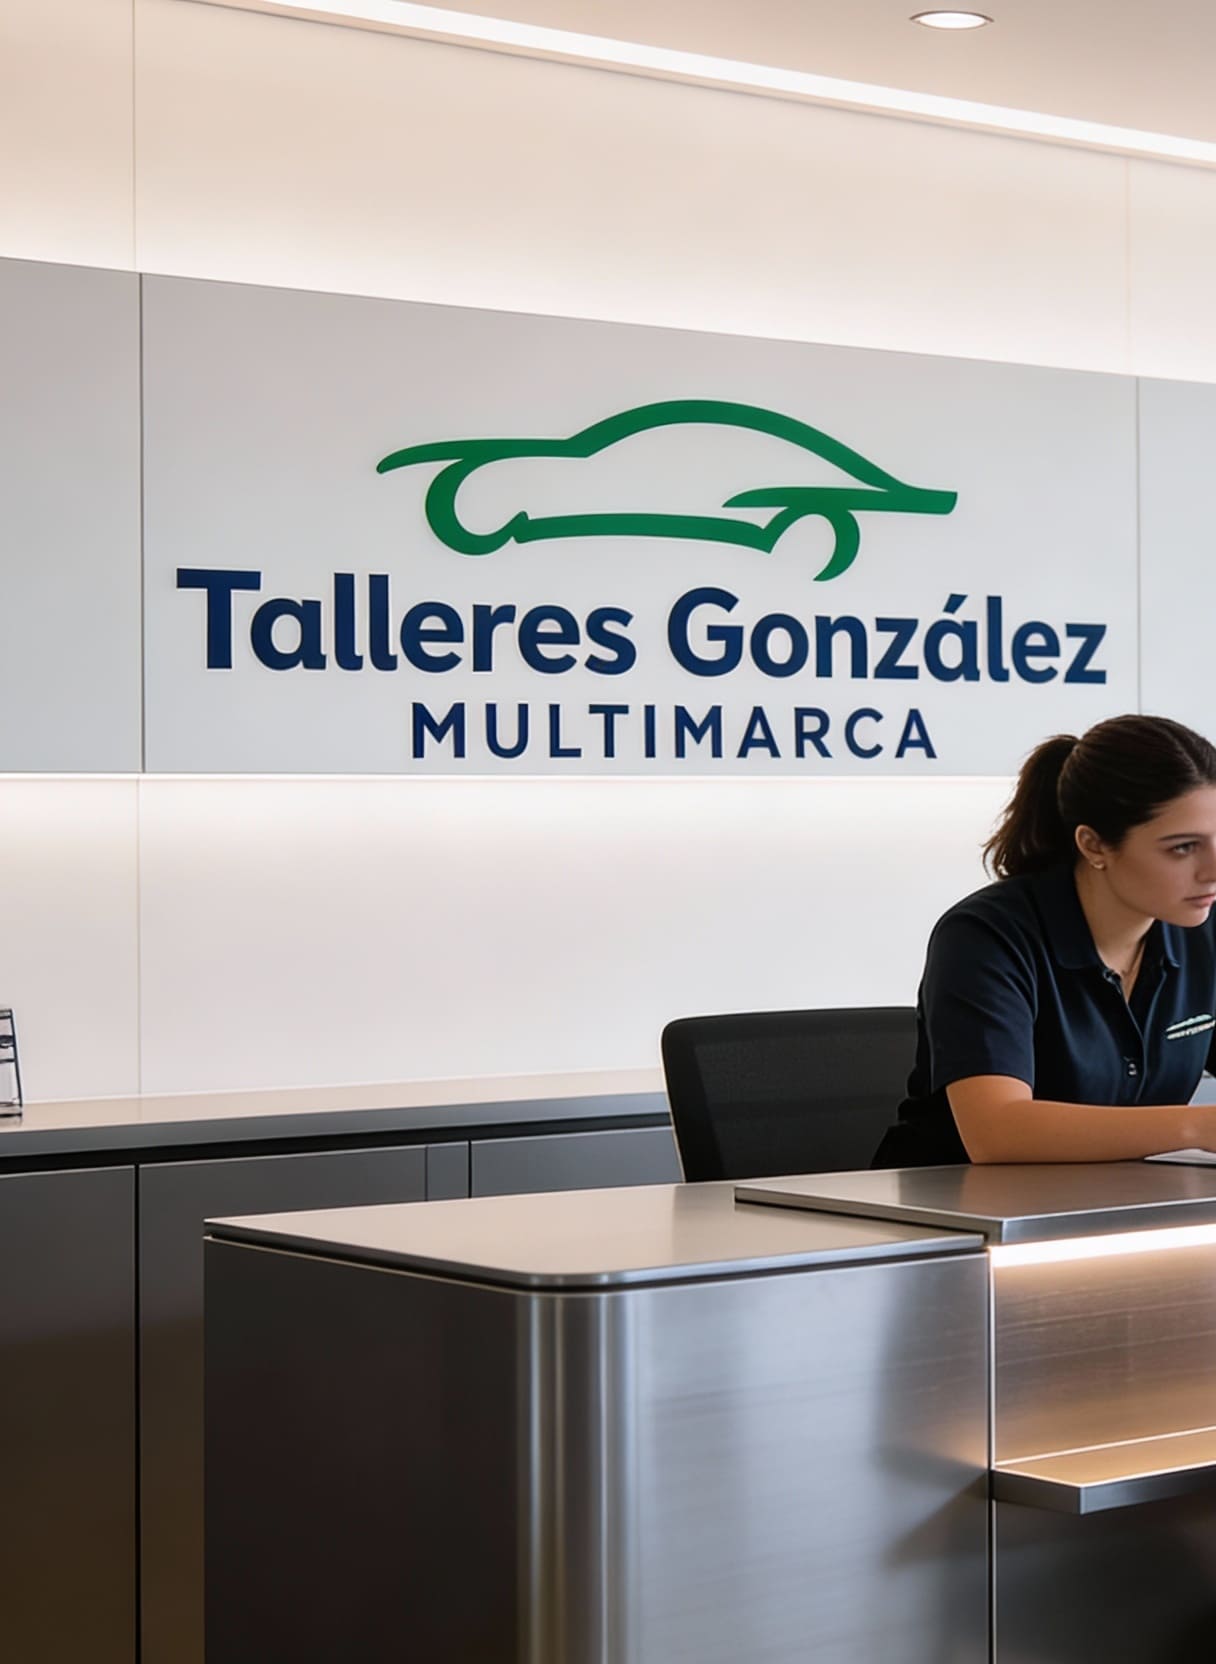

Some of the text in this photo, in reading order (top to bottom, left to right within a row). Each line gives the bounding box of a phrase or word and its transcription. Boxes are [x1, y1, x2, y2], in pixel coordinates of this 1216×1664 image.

[176, 567, 1108, 685] Talleres González
[411, 702, 938, 759] MULTIMARCA
